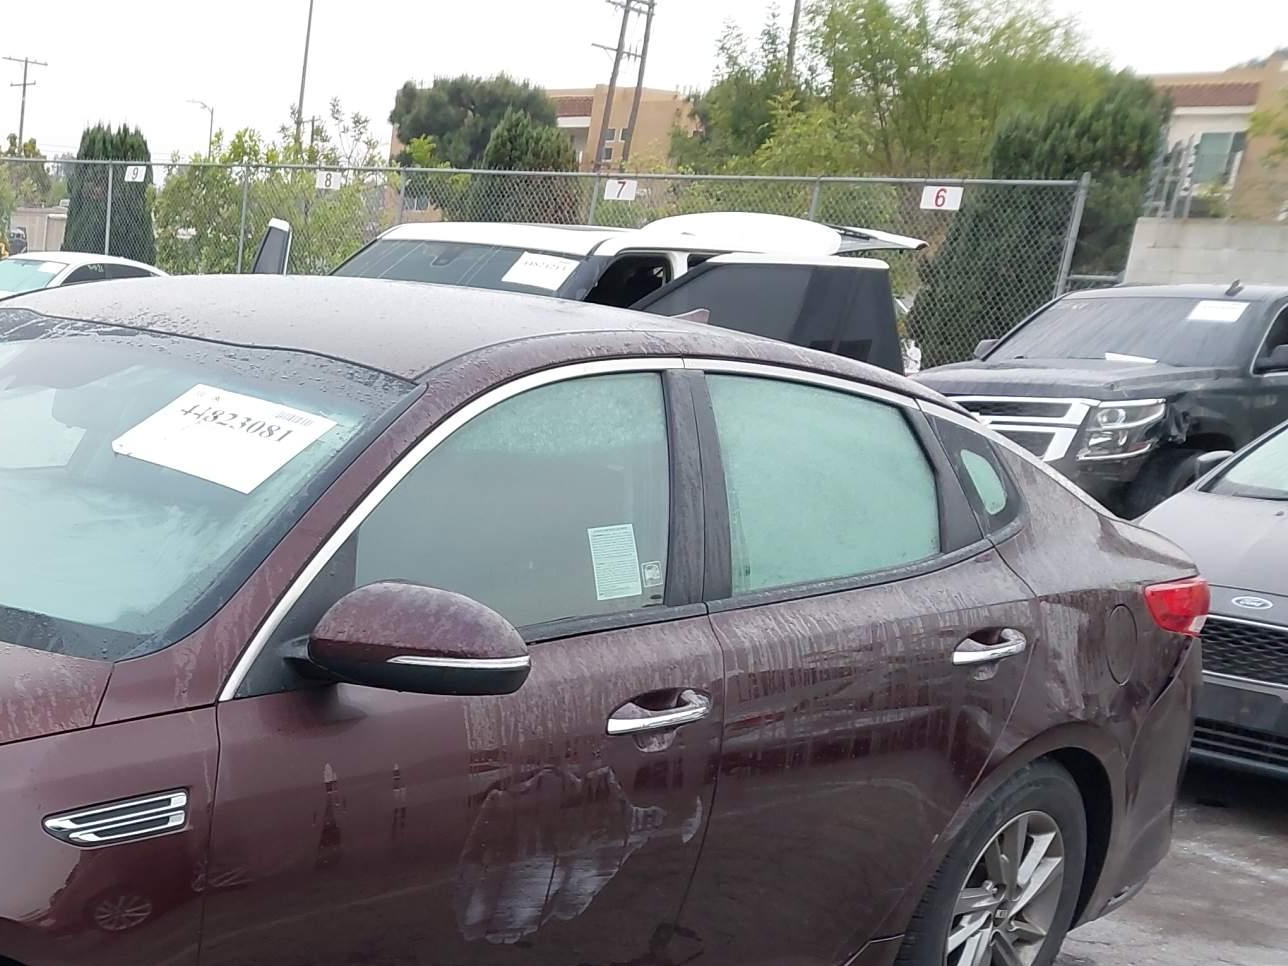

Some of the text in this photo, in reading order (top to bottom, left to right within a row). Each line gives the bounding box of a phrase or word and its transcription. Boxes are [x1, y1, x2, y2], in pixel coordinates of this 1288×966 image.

[131, 167, 139, 180] 9
[324, 172, 332, 188] 8
[616, 180, 627, 198] 7
[934, 187, 948, 207] 6
